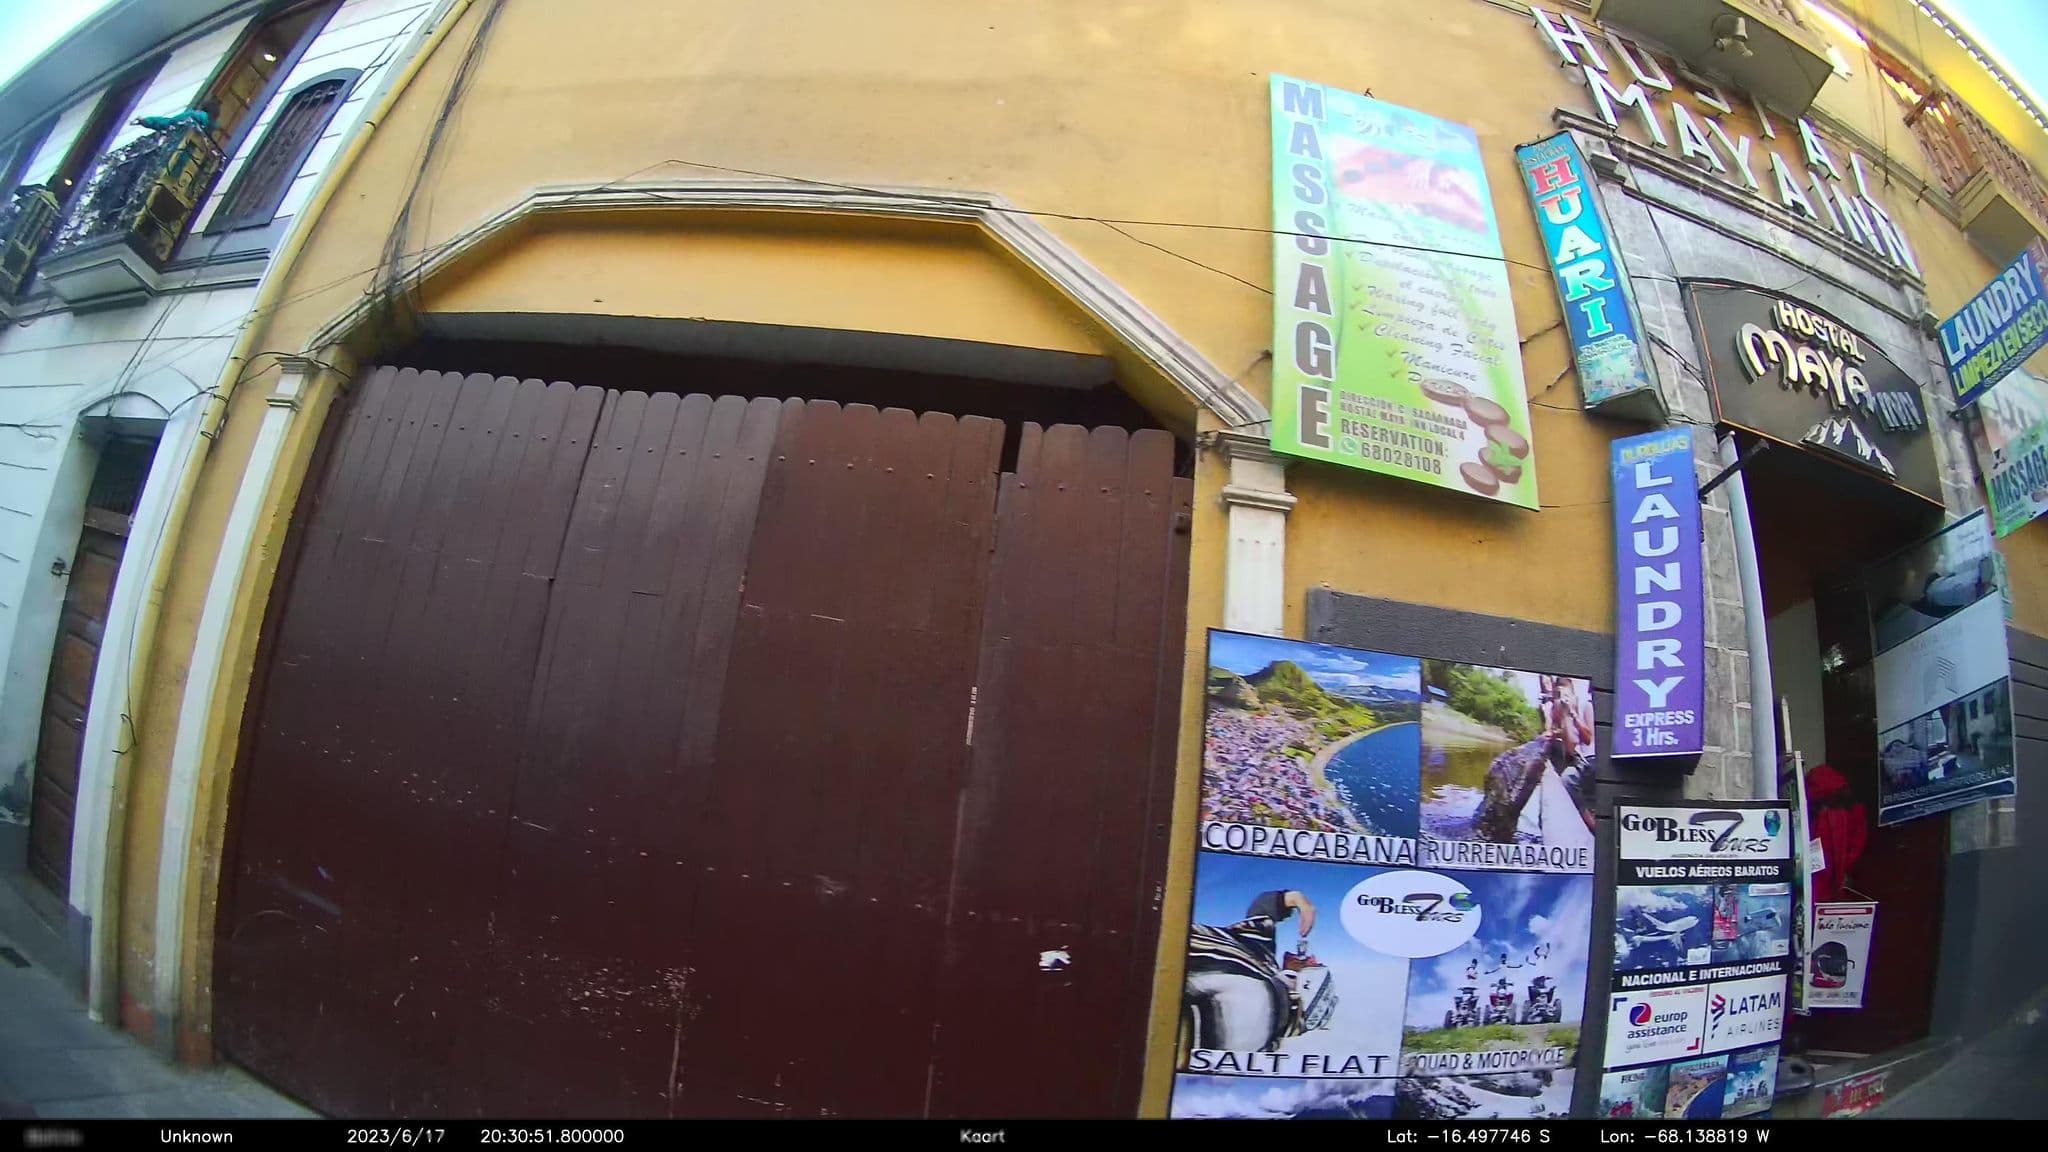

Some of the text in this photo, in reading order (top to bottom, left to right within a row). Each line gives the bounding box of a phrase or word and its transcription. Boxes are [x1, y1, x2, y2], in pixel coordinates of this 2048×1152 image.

[1583, 64, 1921, 280] MAYA INN
[1529, 155, 1615, 339] HUARI
[1282, 81, 1333, 451] MASSAGE
[1941, 252, 2038, 367] LAUNDRY
[1776, 299, 1866, 363] HOSTAL
[1401, 351, 1478, 382] Manicure
[1736, 323, 1923, 430] MAYA INN
[1341, 418, 1449, 458] RESERVATION:
[1361, 442, 1442, 475] 68028108
[1631, 461, 1685, 709] LAUNDRY
[1624, 710, 1694, 729] EXPRESS
[1632, 728, 1679, 747] 3 Hrs.
[1205, 822, 1415, 864] COPACABANA
[1427, 840, 1589, 869] RURRENABAQUE
[1635, 864, 1780, 879] VUELOS AÉREOS BARATOS
[1622, 961, 1783, 988] NACIONAL E INTERNACIONAL
[1654, 1011, 1689, 1024] europ
[1729, 991, 1782, 1016] LATAM
[1627, 1023, 1687, 1039] assistance
[1727, 1017, 1781, 1037] AIRLINES
[1189, 1050, 1391, 1075] SALT FLAT
[1415, 1046, 1567, 1070] QUAD & MOTORCYCLE
